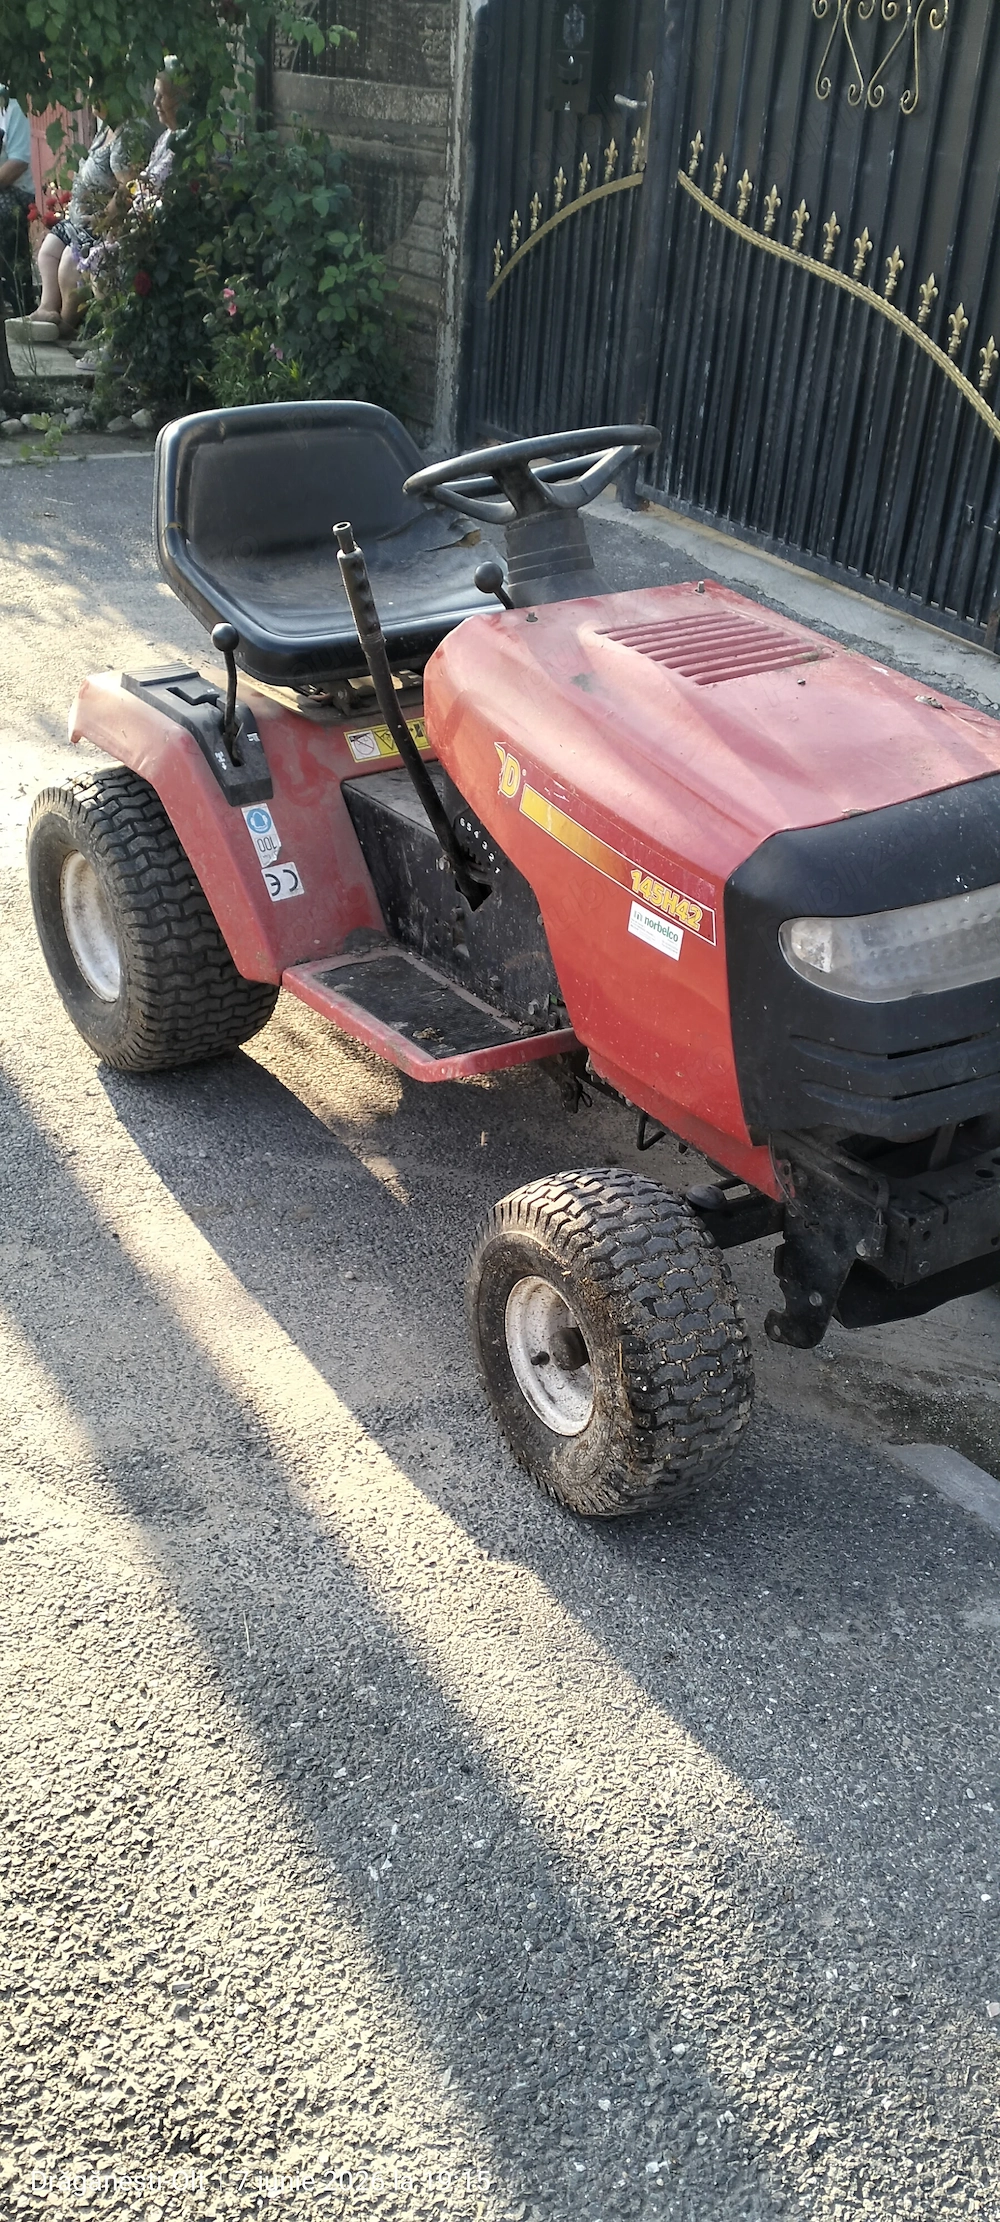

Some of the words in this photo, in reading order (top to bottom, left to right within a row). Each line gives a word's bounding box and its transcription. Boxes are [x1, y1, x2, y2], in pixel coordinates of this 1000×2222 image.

[256, 835, 277, 853] 100
[265, 869, 299, 897] CE
[630, 869, 703, 931] 145H42
[644, 916, 679, 942] norbelco
